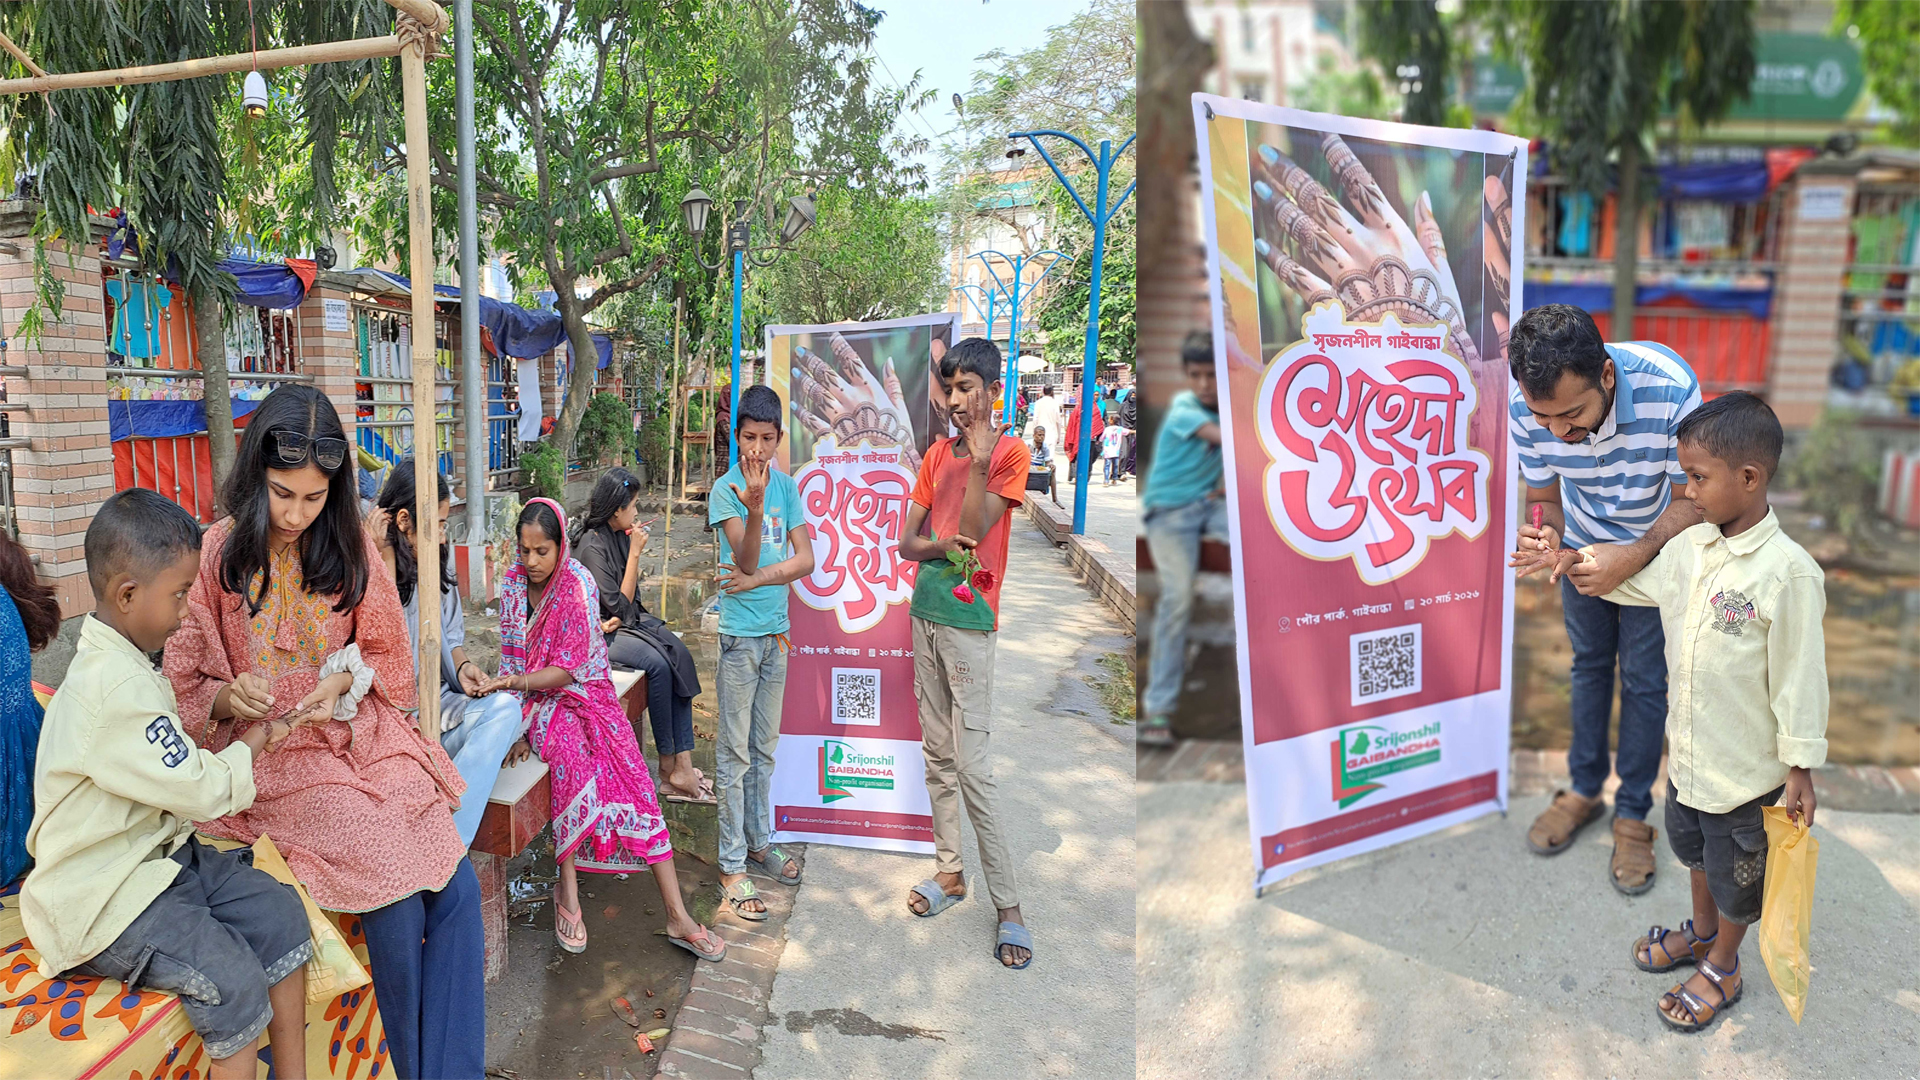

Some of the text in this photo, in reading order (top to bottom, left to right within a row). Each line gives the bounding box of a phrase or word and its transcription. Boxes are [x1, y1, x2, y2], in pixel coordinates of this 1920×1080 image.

[1313, 329, 1441, 353] সৃজনশীল গাইবান্ধা
[1271, 354, 1465, 466] মেহেদী
[818, 451, 898, 468] সৃজনশীল গাইবান্ধা
[1279, 429, 1478, 568] উৎসব
[1420, 590, 1480, 607] ২০ মার্চ ২০২৬
[1296, 614, 1320, 626] পৌর
[1352, 603, 1392, 617] গাইবান্ধা
[146, 715, 189, 768] 3
[1374, 721, 1441, 750] Srijonshil
[846, 753, 894, 766] Srijonshil
[1346, 737, 1440, 769] GAIBANDHA
[828, 766, 894, 777] GAIBANDHA
[828, 777, 858, 786] Non-profit
